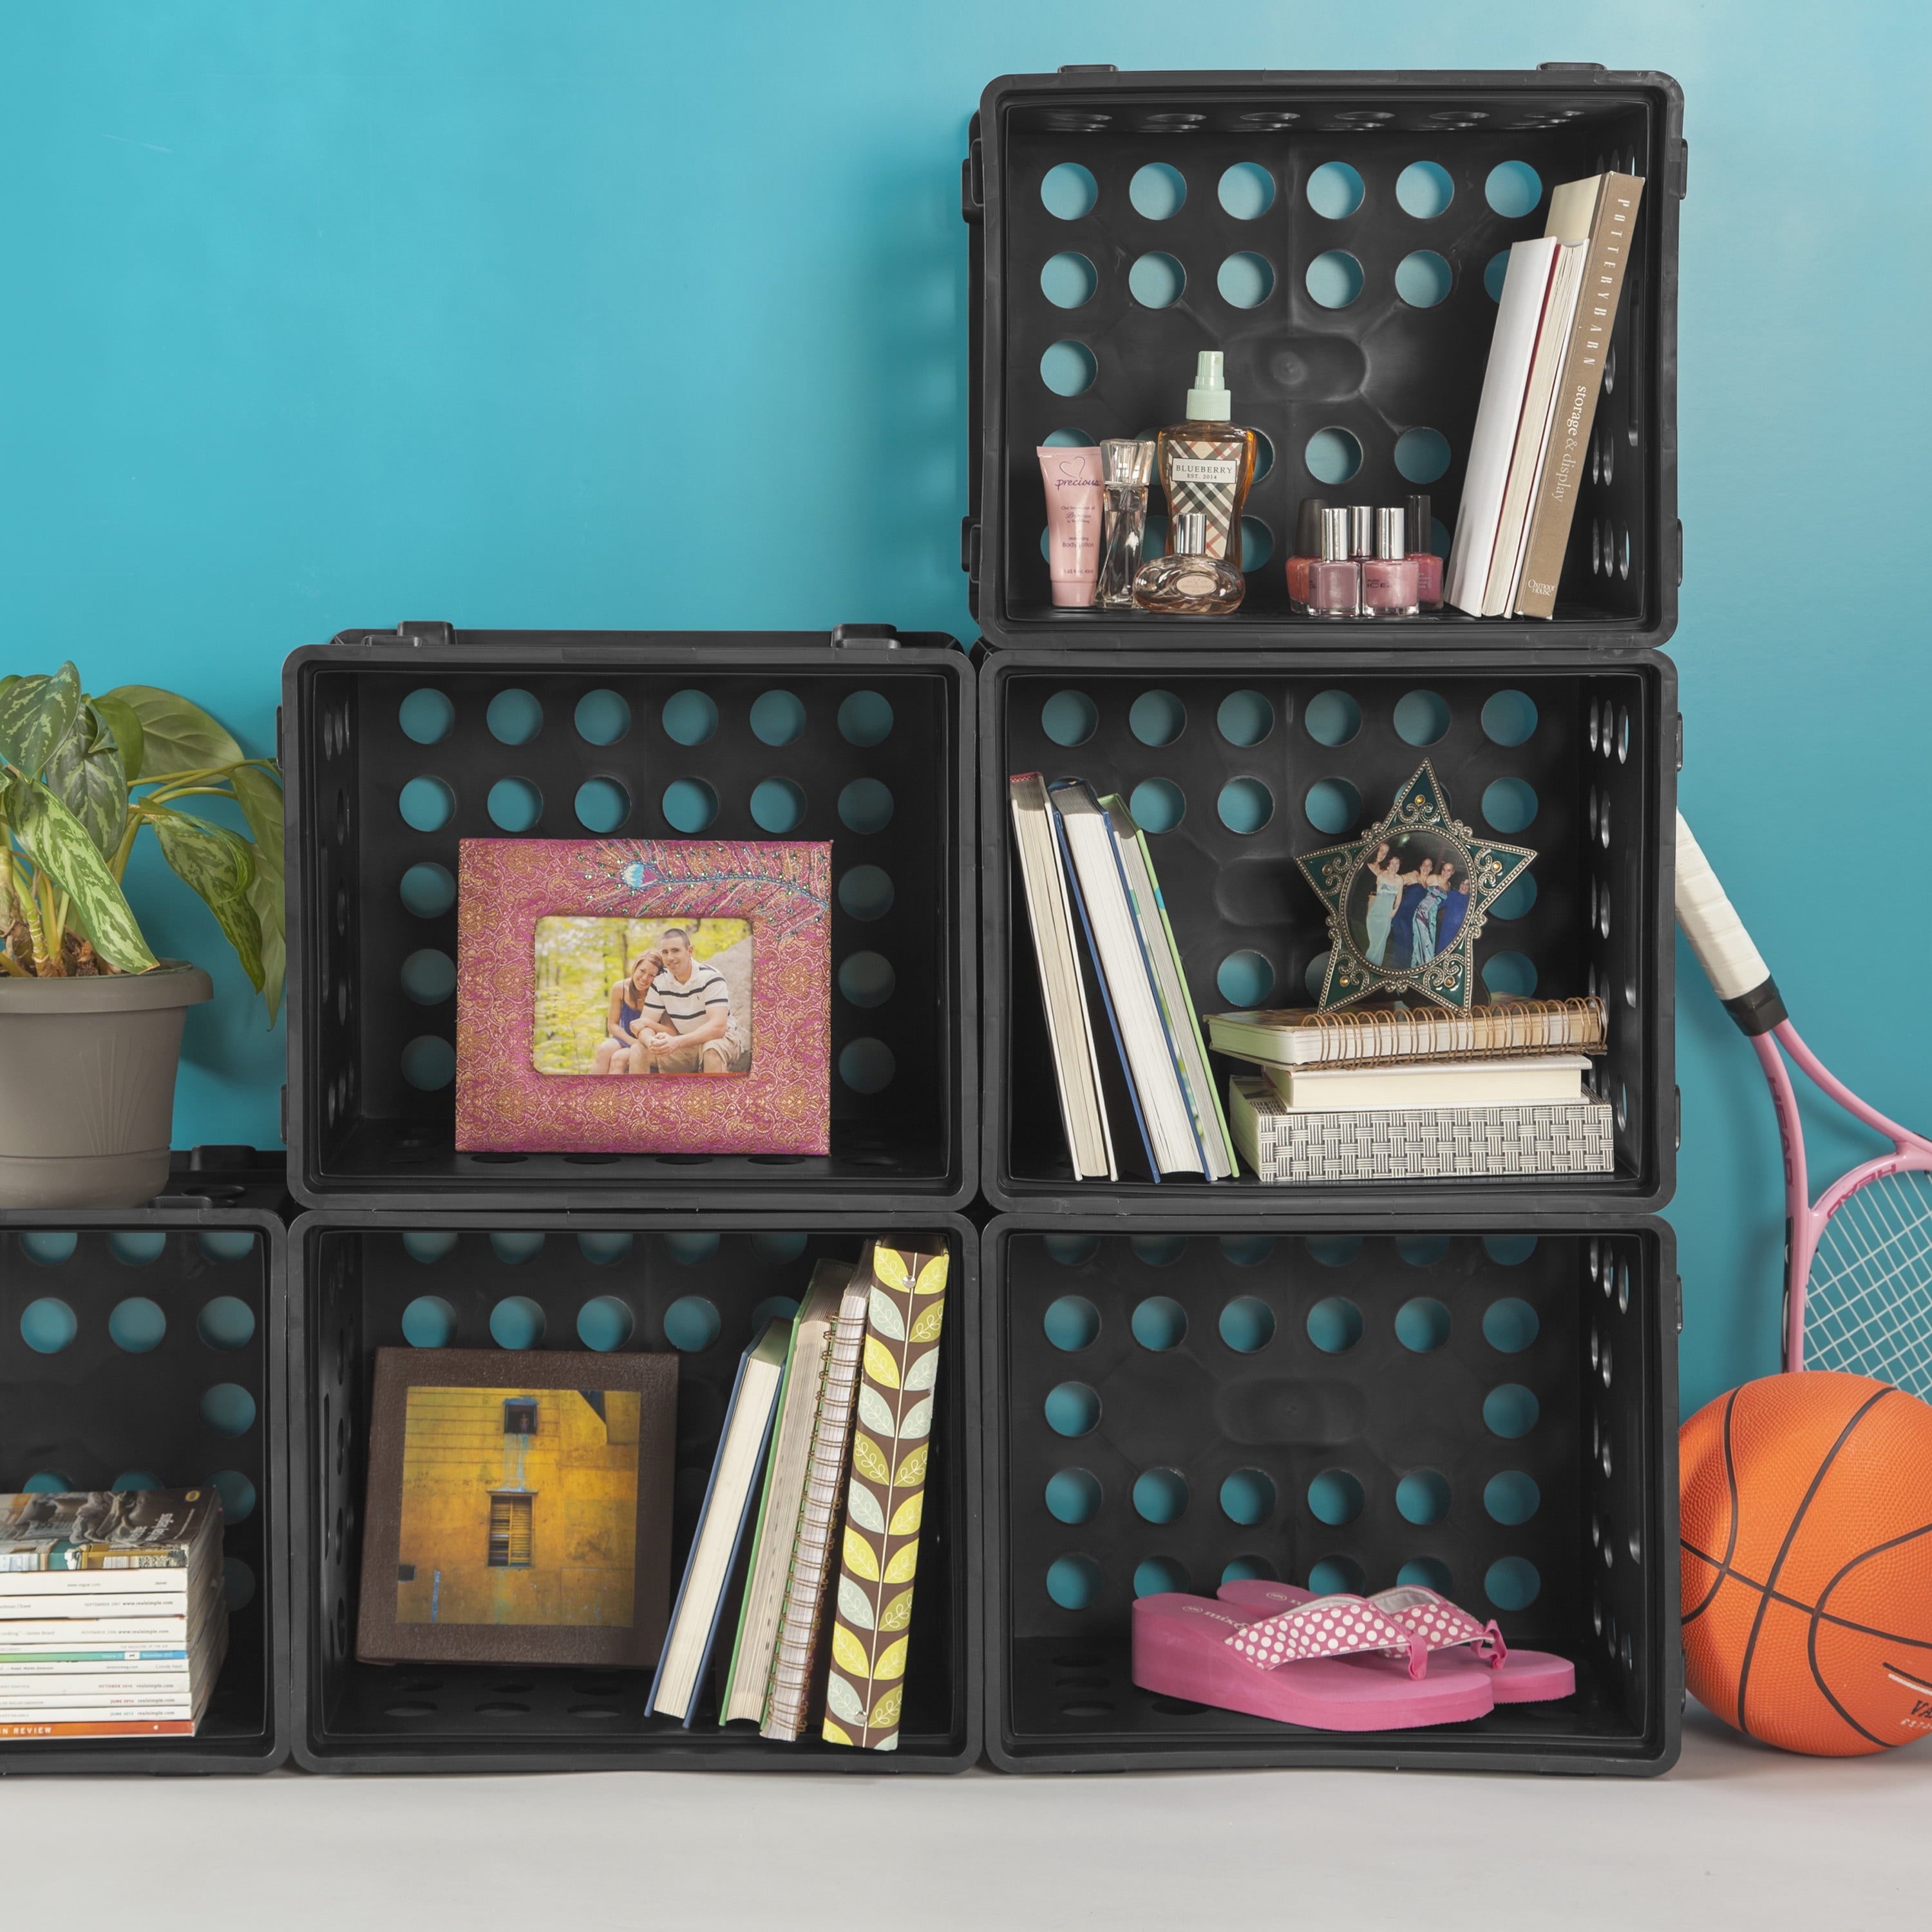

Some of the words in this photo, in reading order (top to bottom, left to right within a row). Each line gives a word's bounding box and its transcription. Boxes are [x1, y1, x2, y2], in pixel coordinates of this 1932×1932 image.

[1566, 386, 1587, 436] storage
[1565, 438, 1578, 451] &
[1176, 465, 1233, 474] BLUEBERRY
[1055, 477, 1101, 491] precious
[1551, 453, 1577, 503] display
[13, 1726, 52, 1734] REVIEW
